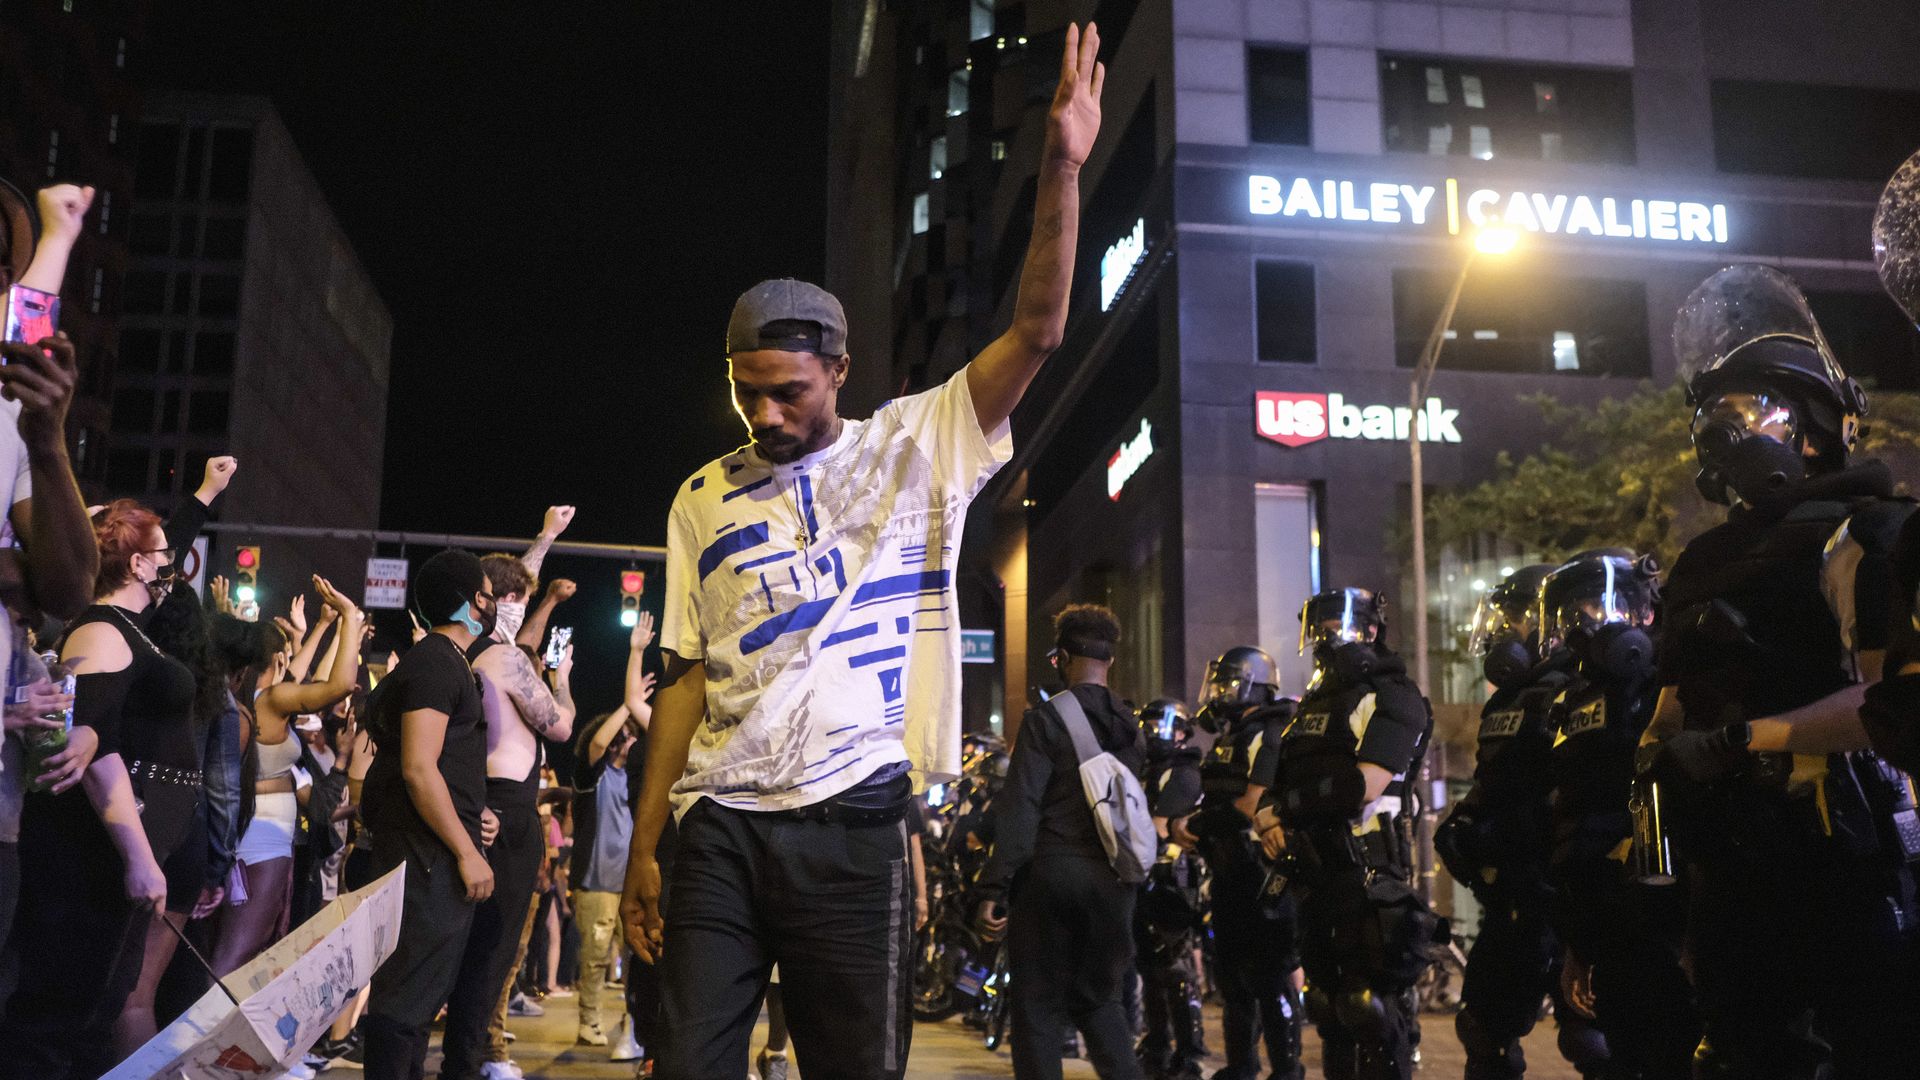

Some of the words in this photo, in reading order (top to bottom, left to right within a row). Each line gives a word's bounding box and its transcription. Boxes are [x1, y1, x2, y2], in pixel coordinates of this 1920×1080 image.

[1249, 175, 1436, 225] BAILEY
[1467, 189, 1729, 243] CAVALIERI
[369, 579, 404, 588] YIELD
